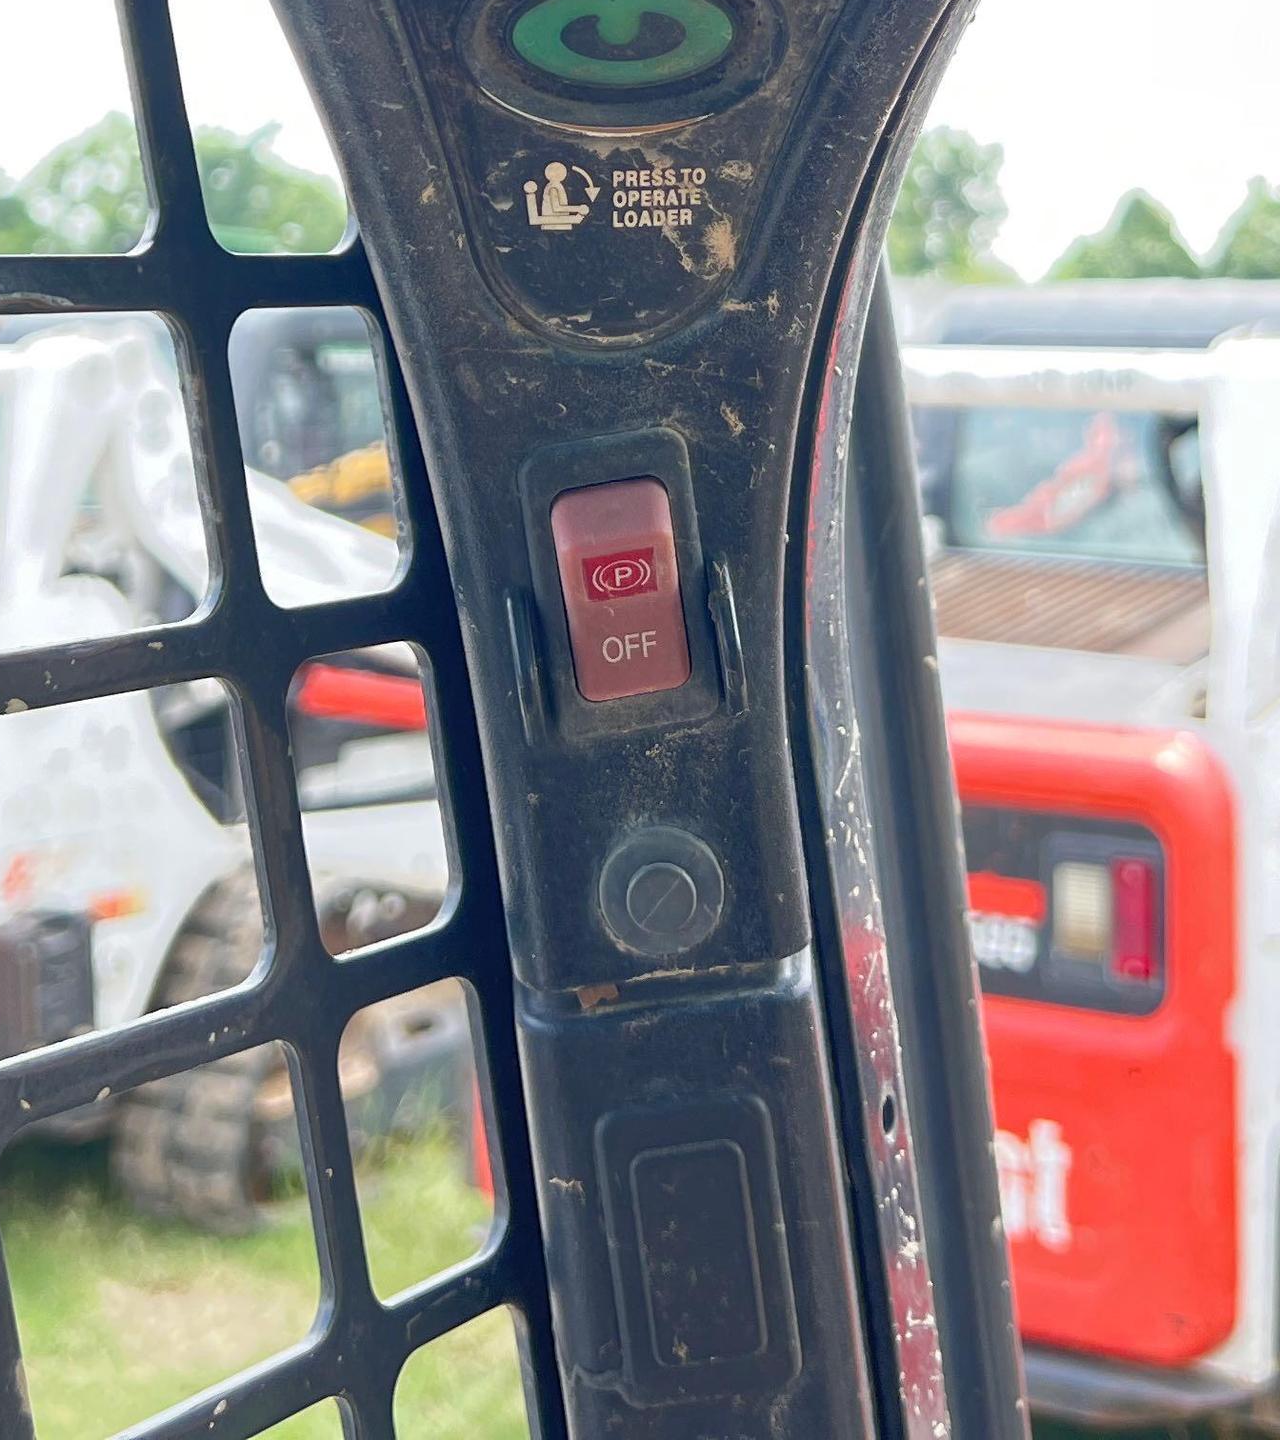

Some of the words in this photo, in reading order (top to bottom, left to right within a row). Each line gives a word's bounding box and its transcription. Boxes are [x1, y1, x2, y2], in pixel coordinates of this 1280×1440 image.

[612, 168, 677, 187] PRESS
[680, 167, 707, 185] TO
[612, 188, 702, 208] OPERATE
[612, 208, 693, 228] LOADER
[614, 566, 633, 587] P
[602, 630, 657, 663] OFF
